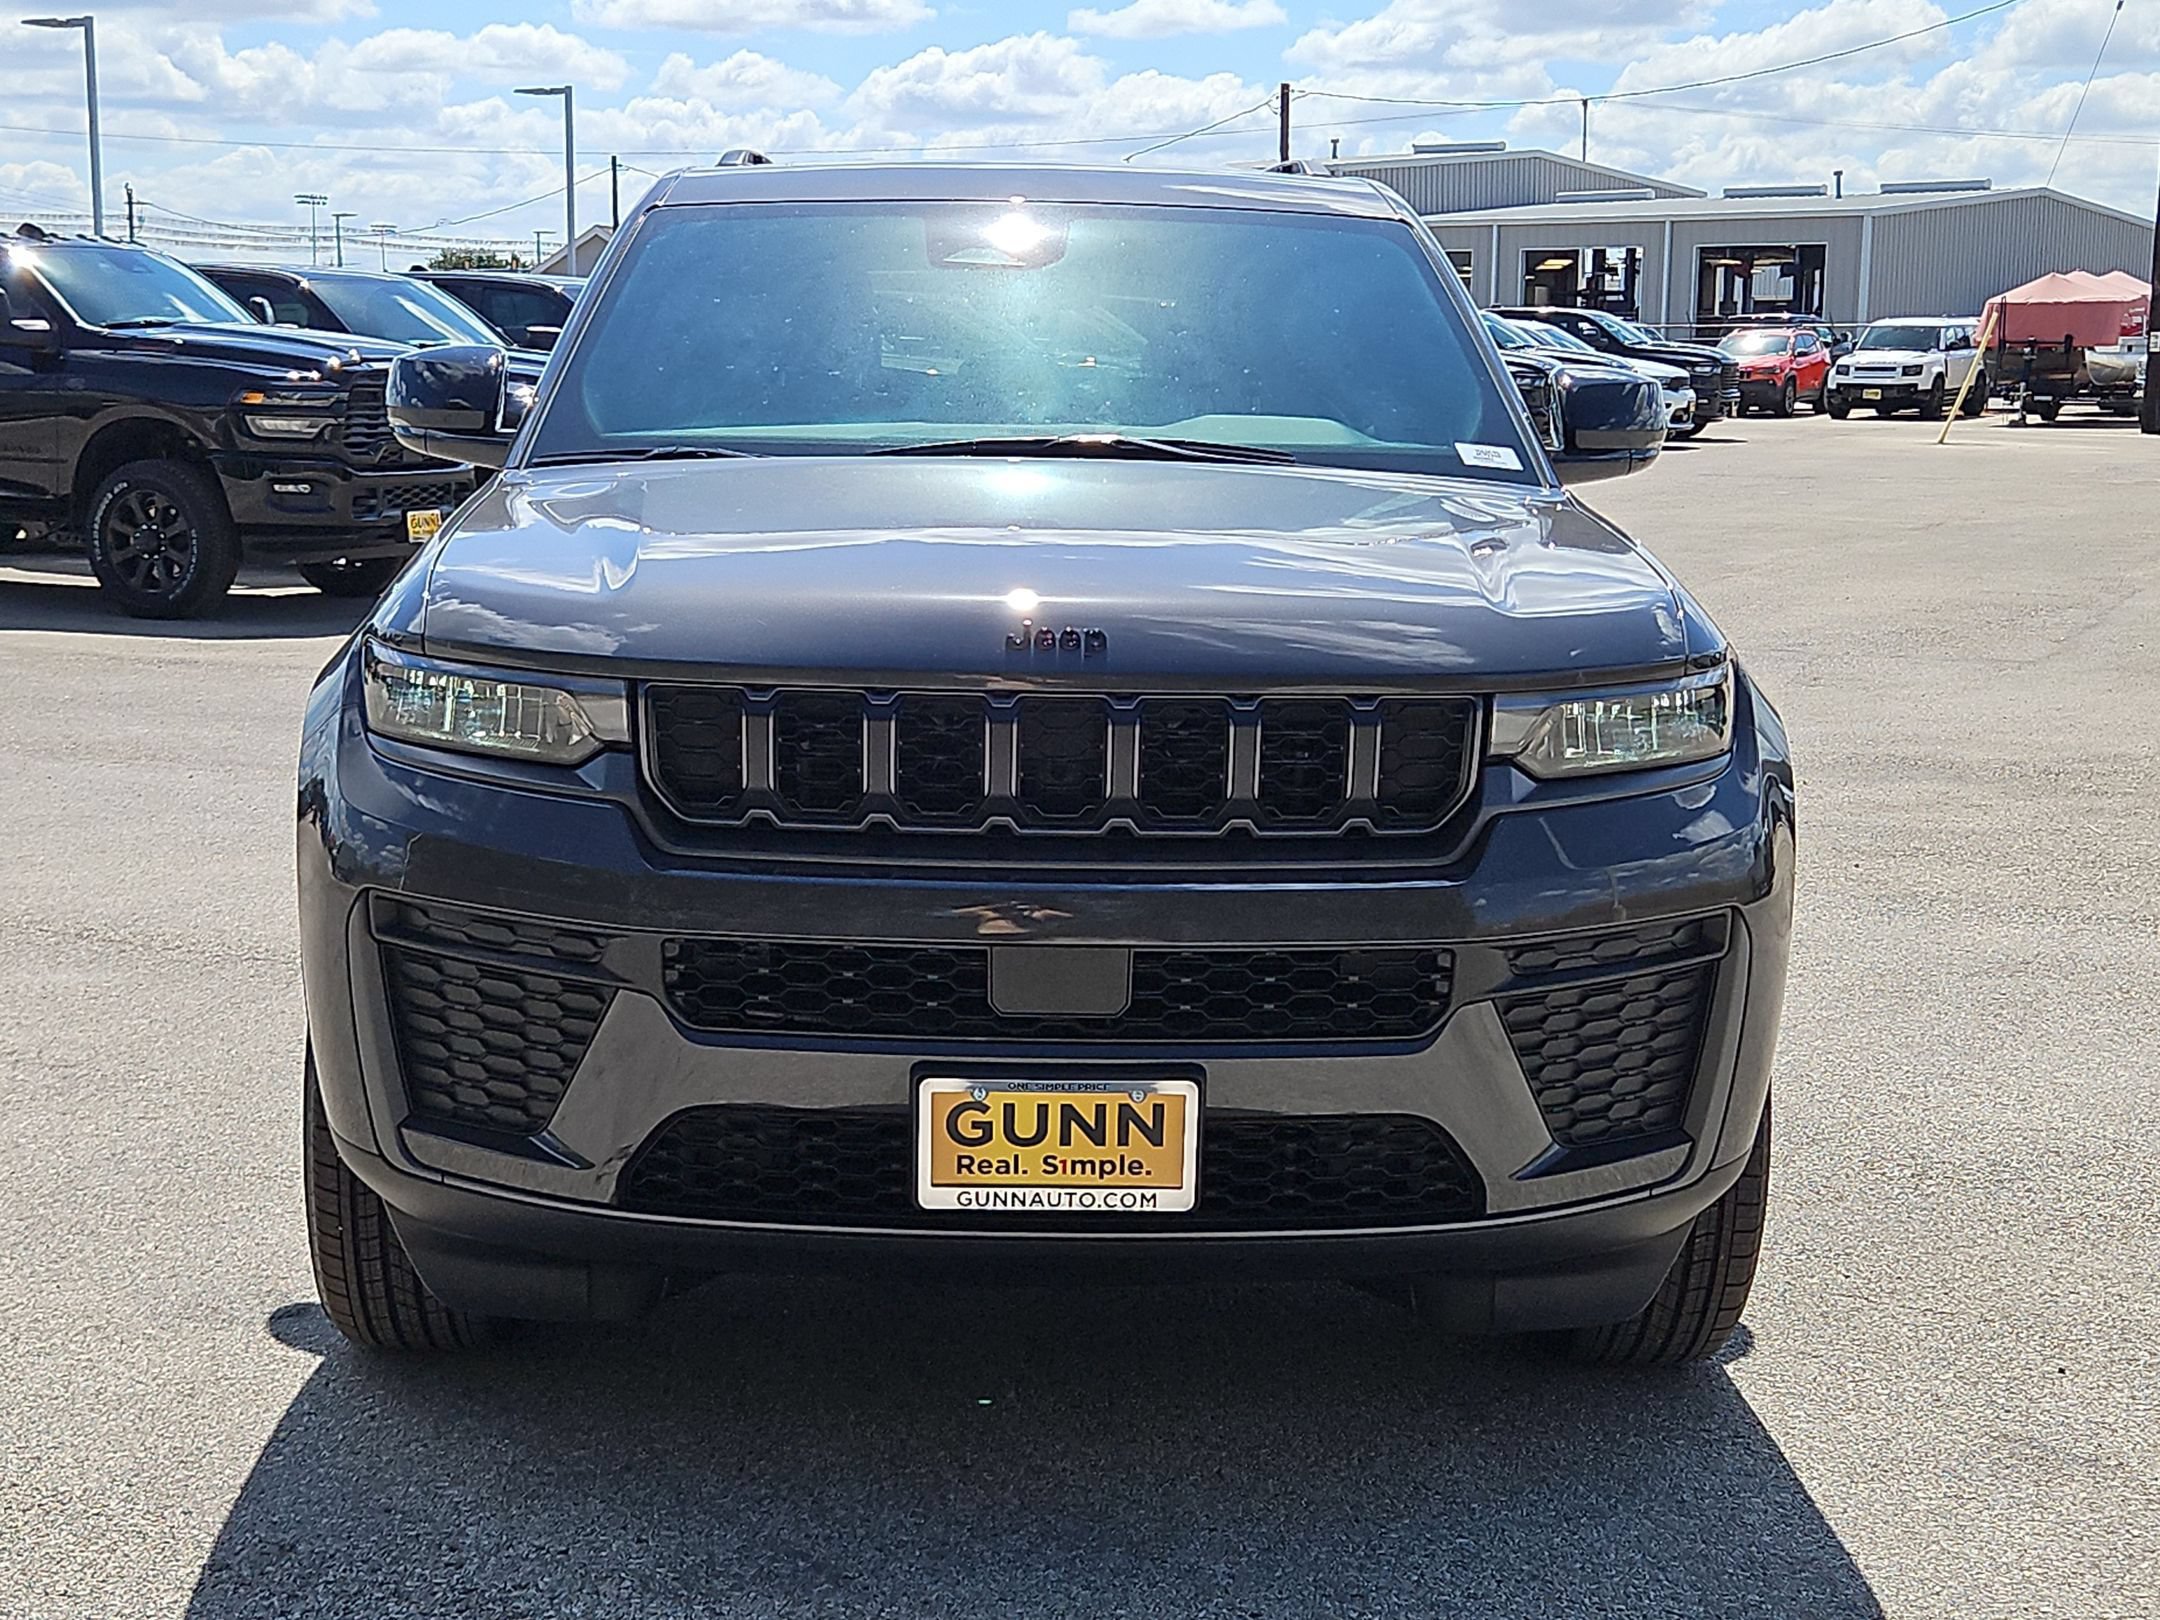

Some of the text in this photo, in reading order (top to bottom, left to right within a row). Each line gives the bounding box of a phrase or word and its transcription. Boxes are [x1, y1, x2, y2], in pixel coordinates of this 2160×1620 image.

[1005, 619, 1108, 658] Jeep
[1007, 1082, 1110, 1091] ONE SIMPLE PRICE
[945, 1100, 1165, 1148] GUNN
[956, 1154, 1028, 1175] Real.
[956, 1191, 1158, 1209] GUNNAUTO.COM
